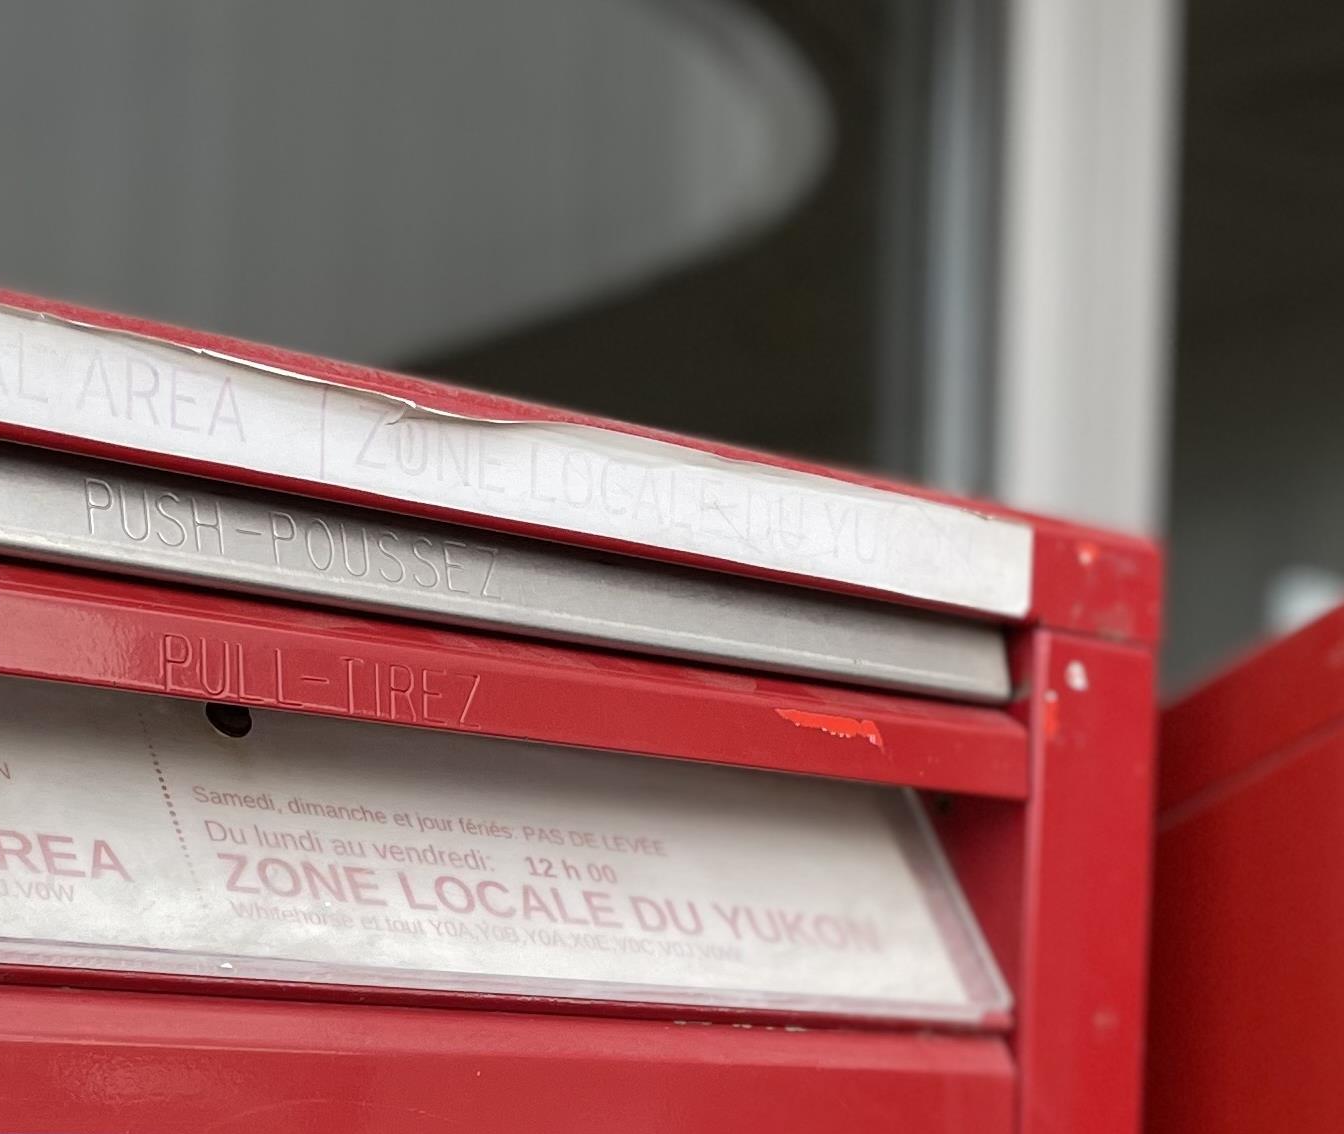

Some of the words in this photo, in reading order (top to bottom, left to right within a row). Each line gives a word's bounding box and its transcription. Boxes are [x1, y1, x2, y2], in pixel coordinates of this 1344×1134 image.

[70, 346, 247, 443] AREA
[354, 404, 506, 493] ZONE
[192, 785, 283, 814] Samedi,
[287, 796, 388, 825] dimanche
[393, 811, 411, 828] et
[415, 815, 455, 833] jour
[522, 825, 566, 846] PAS
[567, 830, 599, 849] DE
[204, 818, 248, 846] Du
[253, 824, 323, 853] lundi
[329, 837, 367, 860] au
[372, 840, 496, 872] vendredi:
[524, 855, 558, 879] 12
[561, 858, 582, 881] h
[586, 863, 619, 885] 00
[216, 851, 389, 907] ZONE
[396, 869, 623, 932] LOCALE
[629, 893, 706, 938] DU
[711, 899, 885, 955] YUKON
